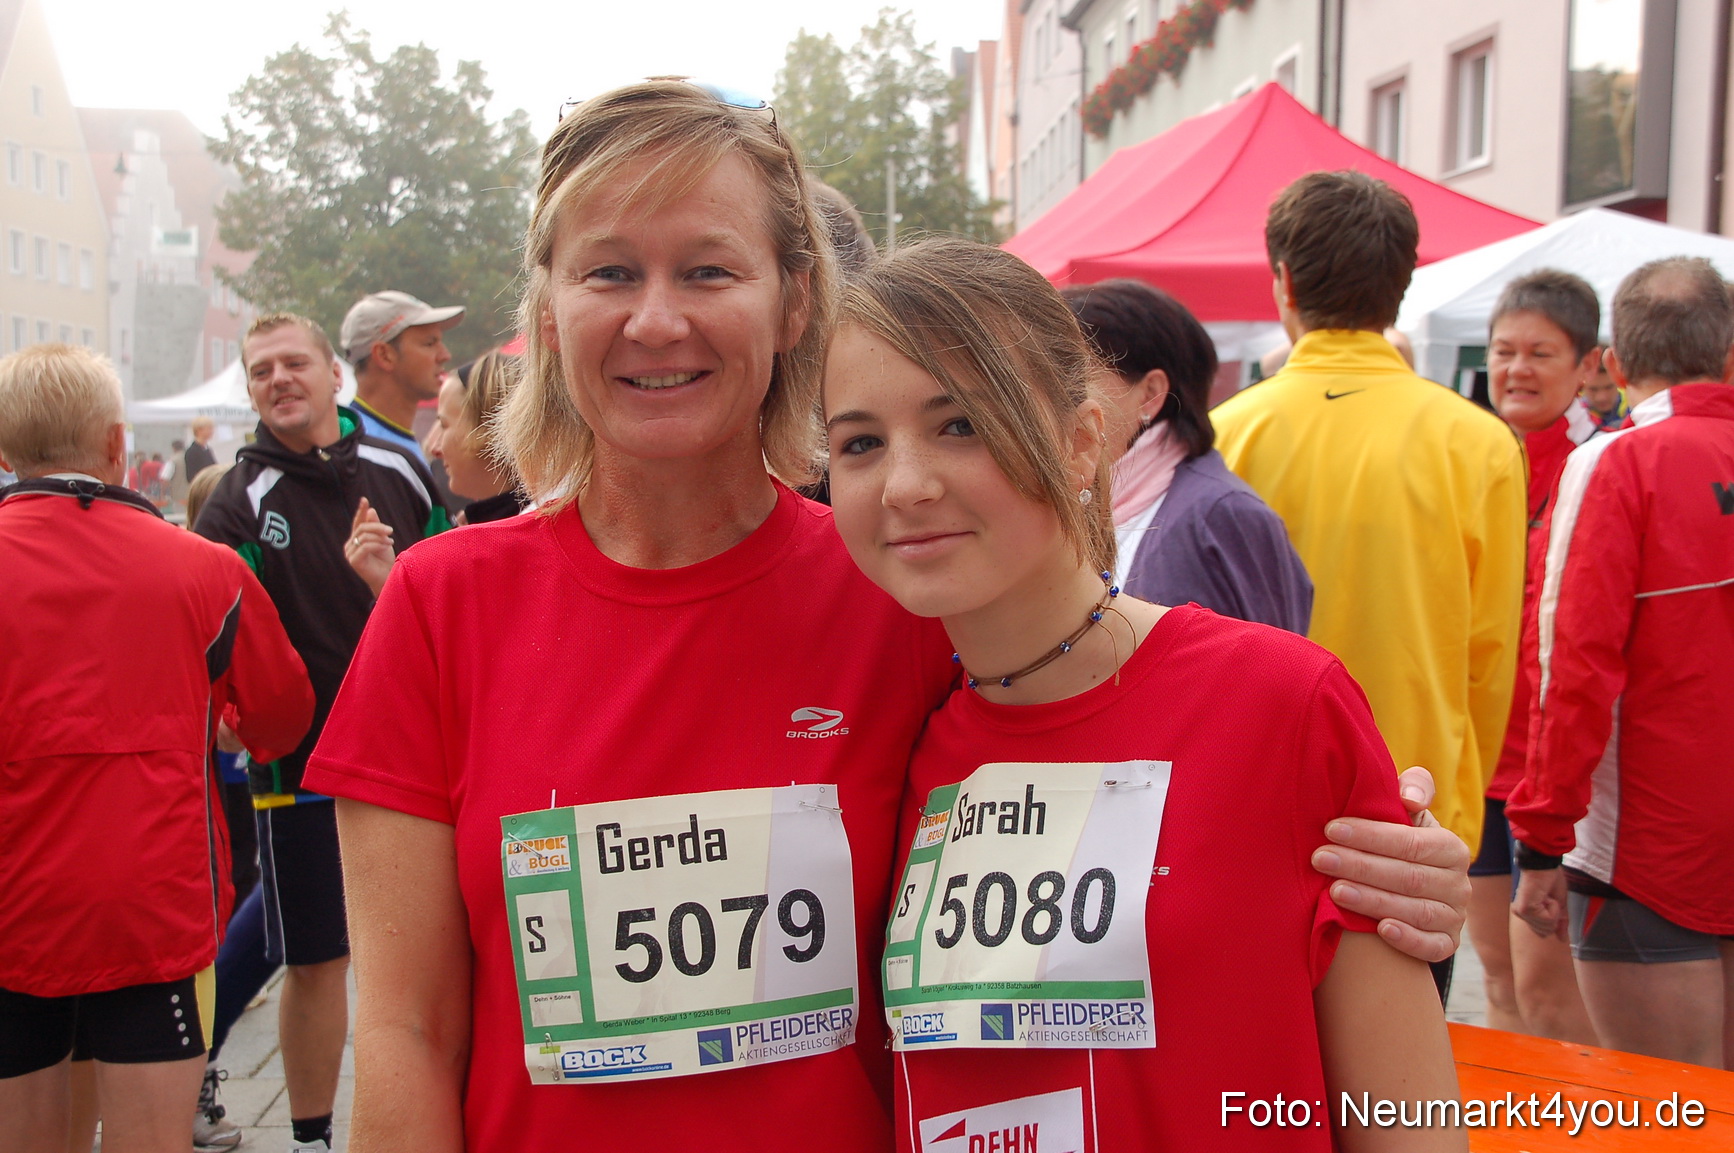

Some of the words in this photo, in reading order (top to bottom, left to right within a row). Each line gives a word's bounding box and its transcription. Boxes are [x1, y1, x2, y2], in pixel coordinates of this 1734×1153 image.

[786, 727, 850, 739] BROOKS
[952, 784, 1046, 843] Sarah
[596, 814, 728, 874] Gerda
[898, 884, 916, 918] S
[935, 867, 1116, 949] 5080
[525, 916, 546, 953] S
[615, 888, 826, 983] 5079
[987, 982, 1005, 990] 92358
[602, 1021, 622, 1029] Gerda
[624, 1018, 646, 1027] Weber
[659, 1015, 678, 1023] Spital
[693, 1010, 714, 1018] 92348
[715, 1008, 731, 1016] Berg
[736, 1008, 853, 1046] PFLEIDERER
[902, 1013, 944, 1035] BOCK
[1017, 1002, 1147, 1025] PFLEIDERER
[1018, 1030, 1149, 1042] AKTIENGESELLSCHAFT
[561, 1044, 647, 1070] BOCK
